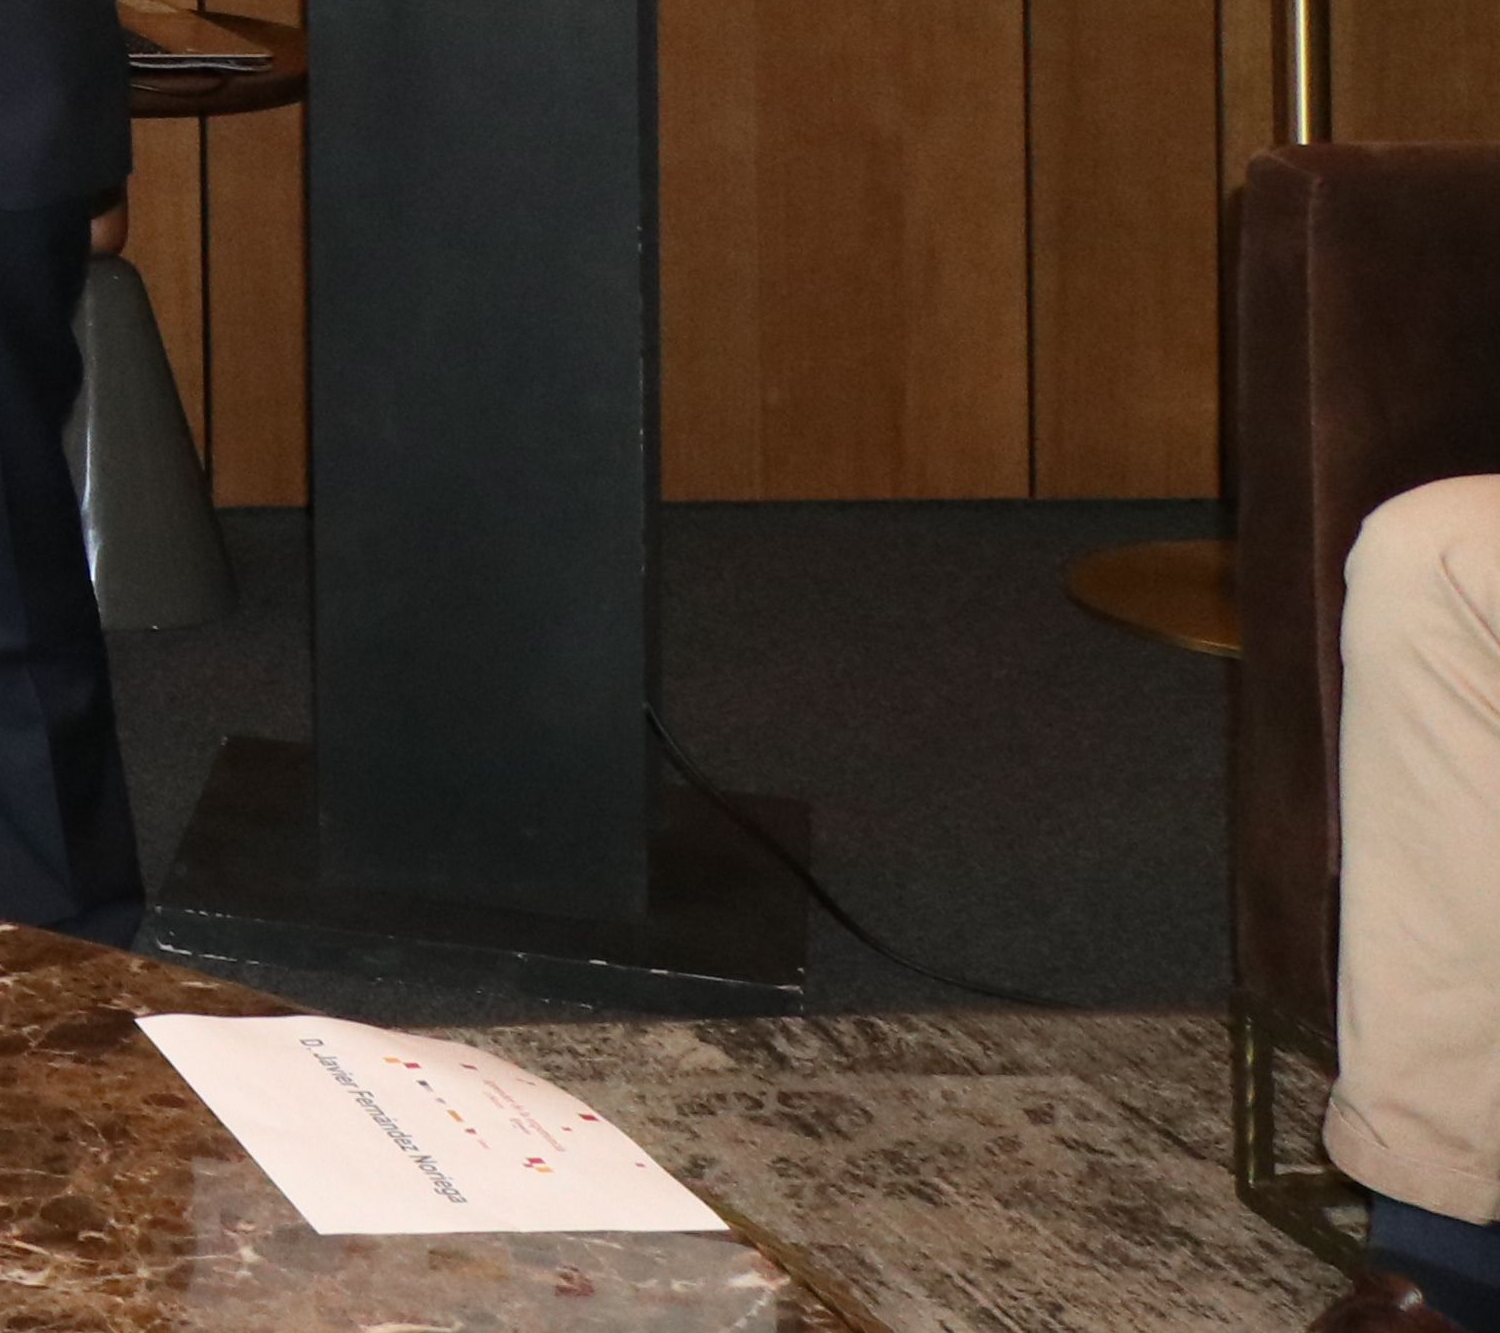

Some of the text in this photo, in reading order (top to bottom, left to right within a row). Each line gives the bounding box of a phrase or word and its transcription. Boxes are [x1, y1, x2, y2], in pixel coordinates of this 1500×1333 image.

[299, 1037, 325, 1052] D.
[312, 1051, 359, 1089] Javier
[408, 1153, 468, 1205] Noriega
